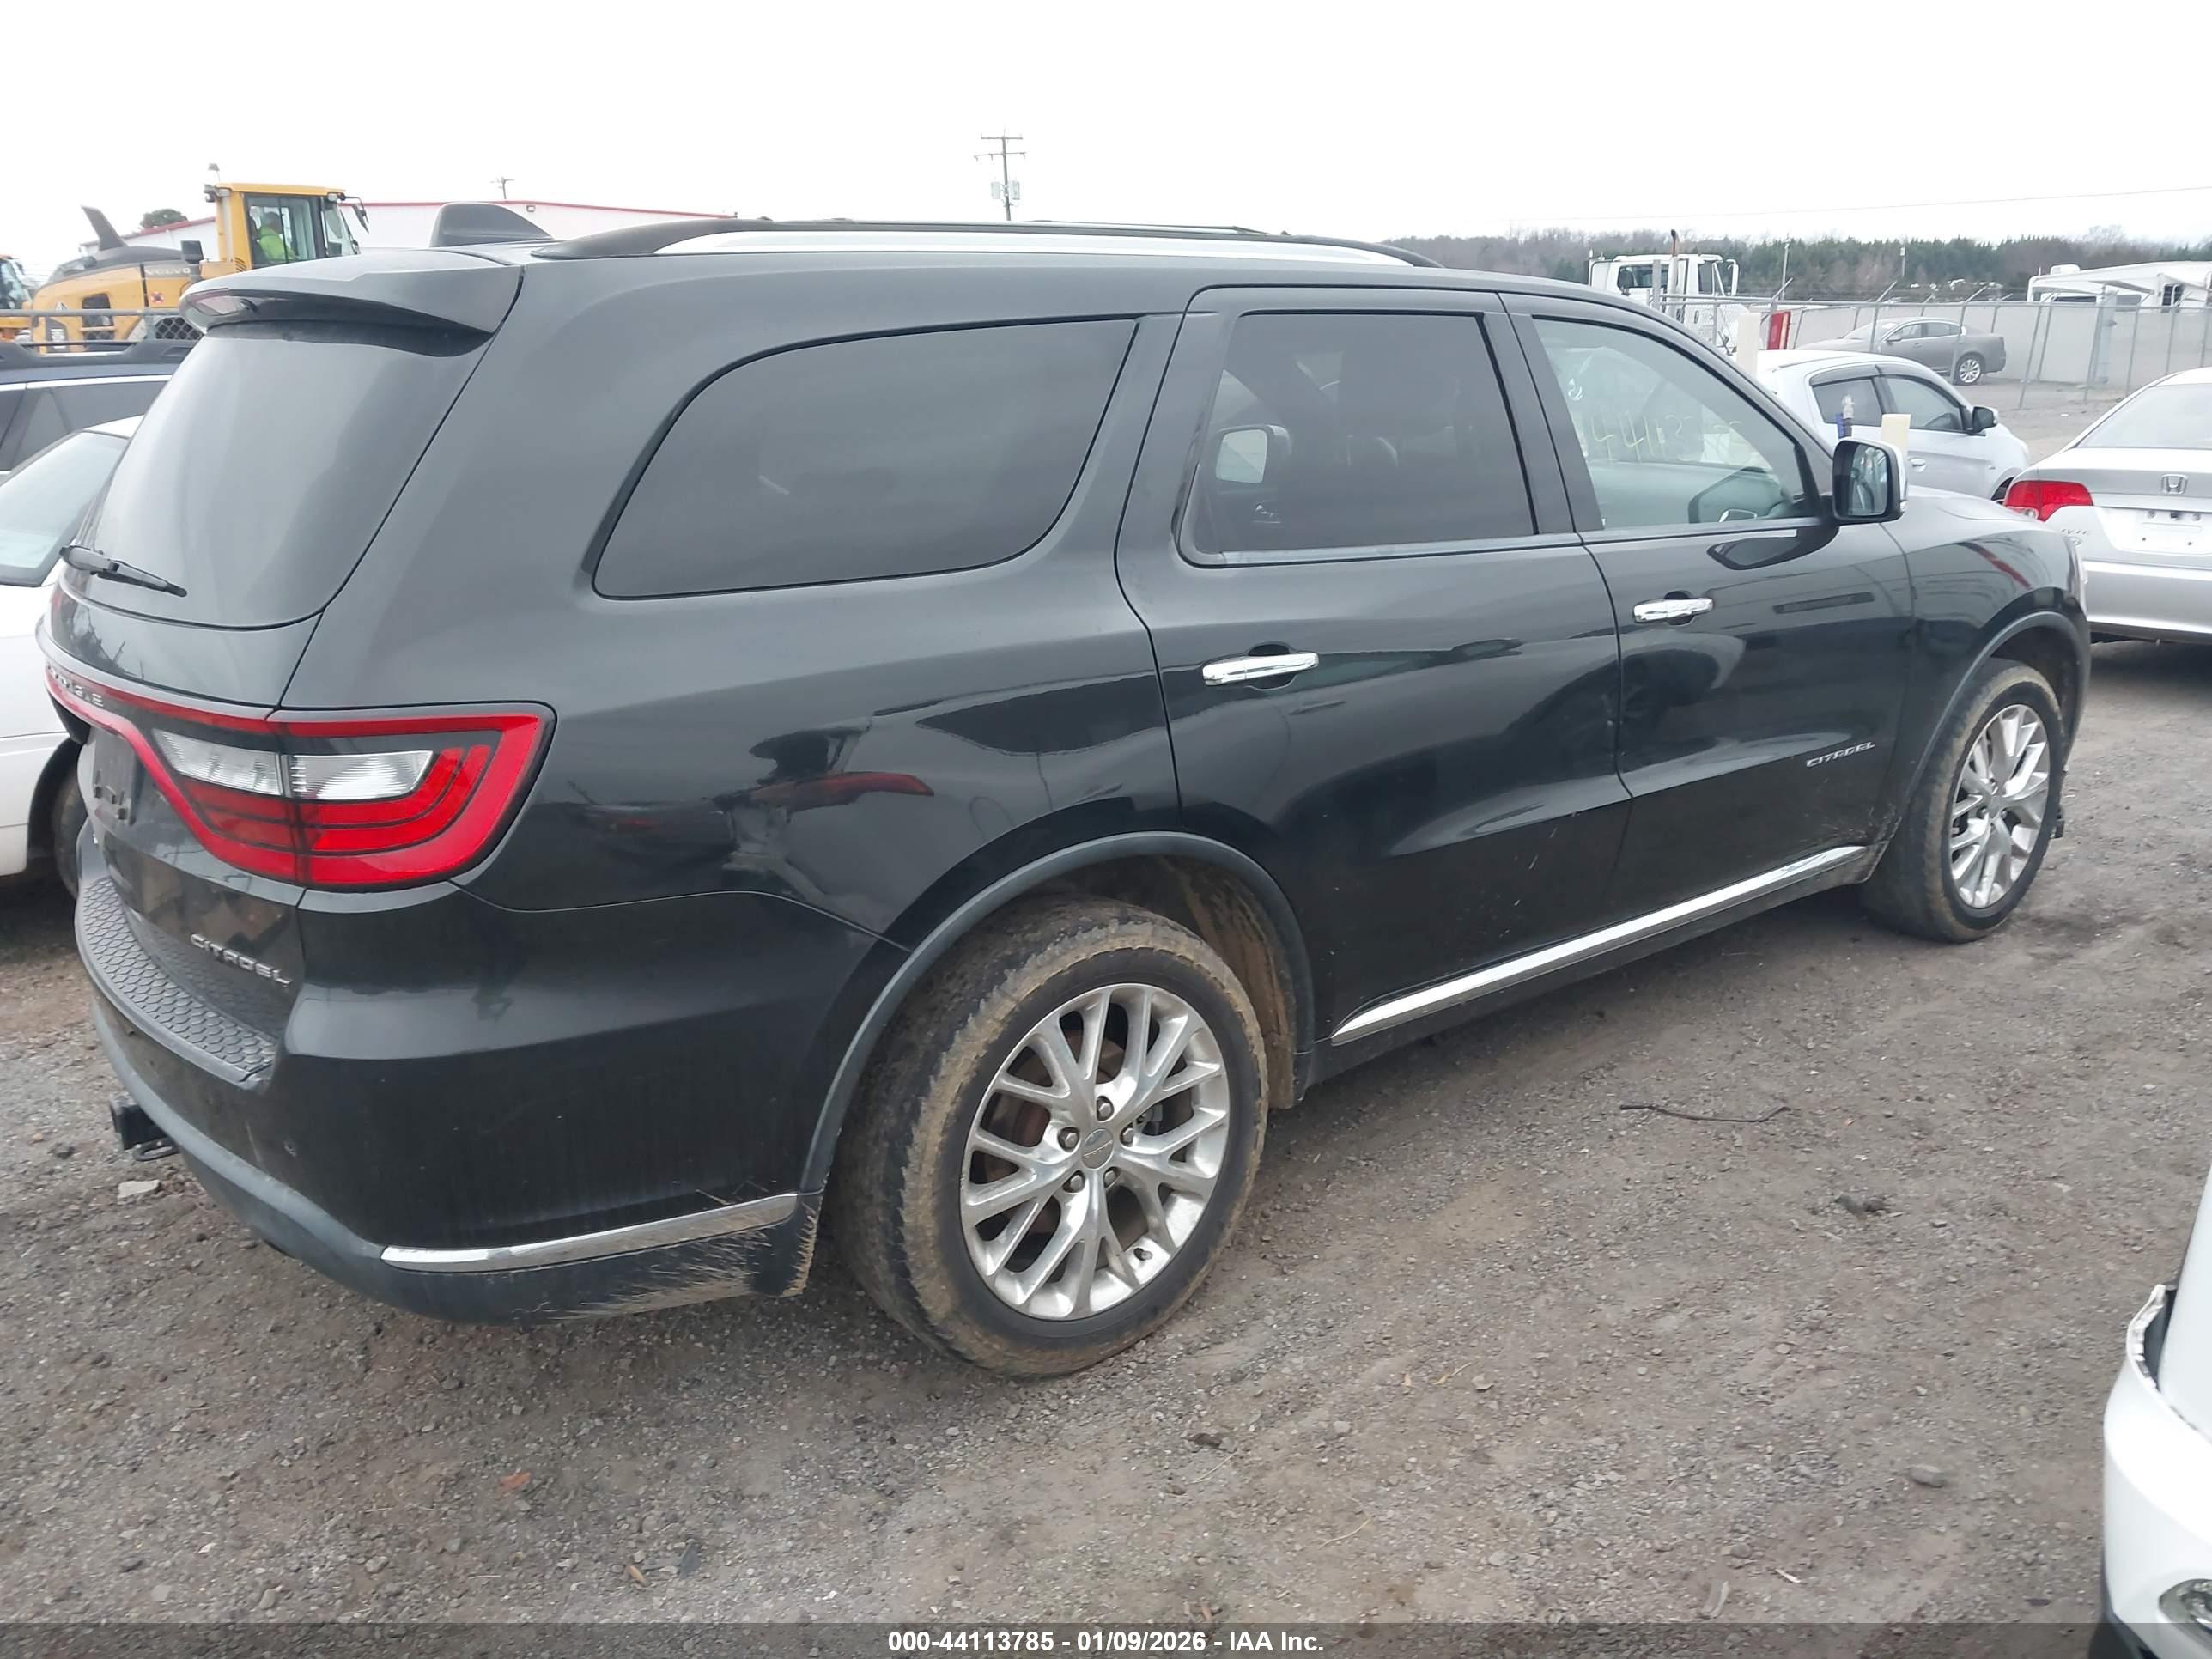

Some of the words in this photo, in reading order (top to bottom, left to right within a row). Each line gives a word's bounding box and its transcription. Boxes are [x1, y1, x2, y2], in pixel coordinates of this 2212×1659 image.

[144, 267, 191, 276] VOLVO
[1806, 741, 1876, 767] CITADEL
[191, 933, 293, 985] CITADEL
